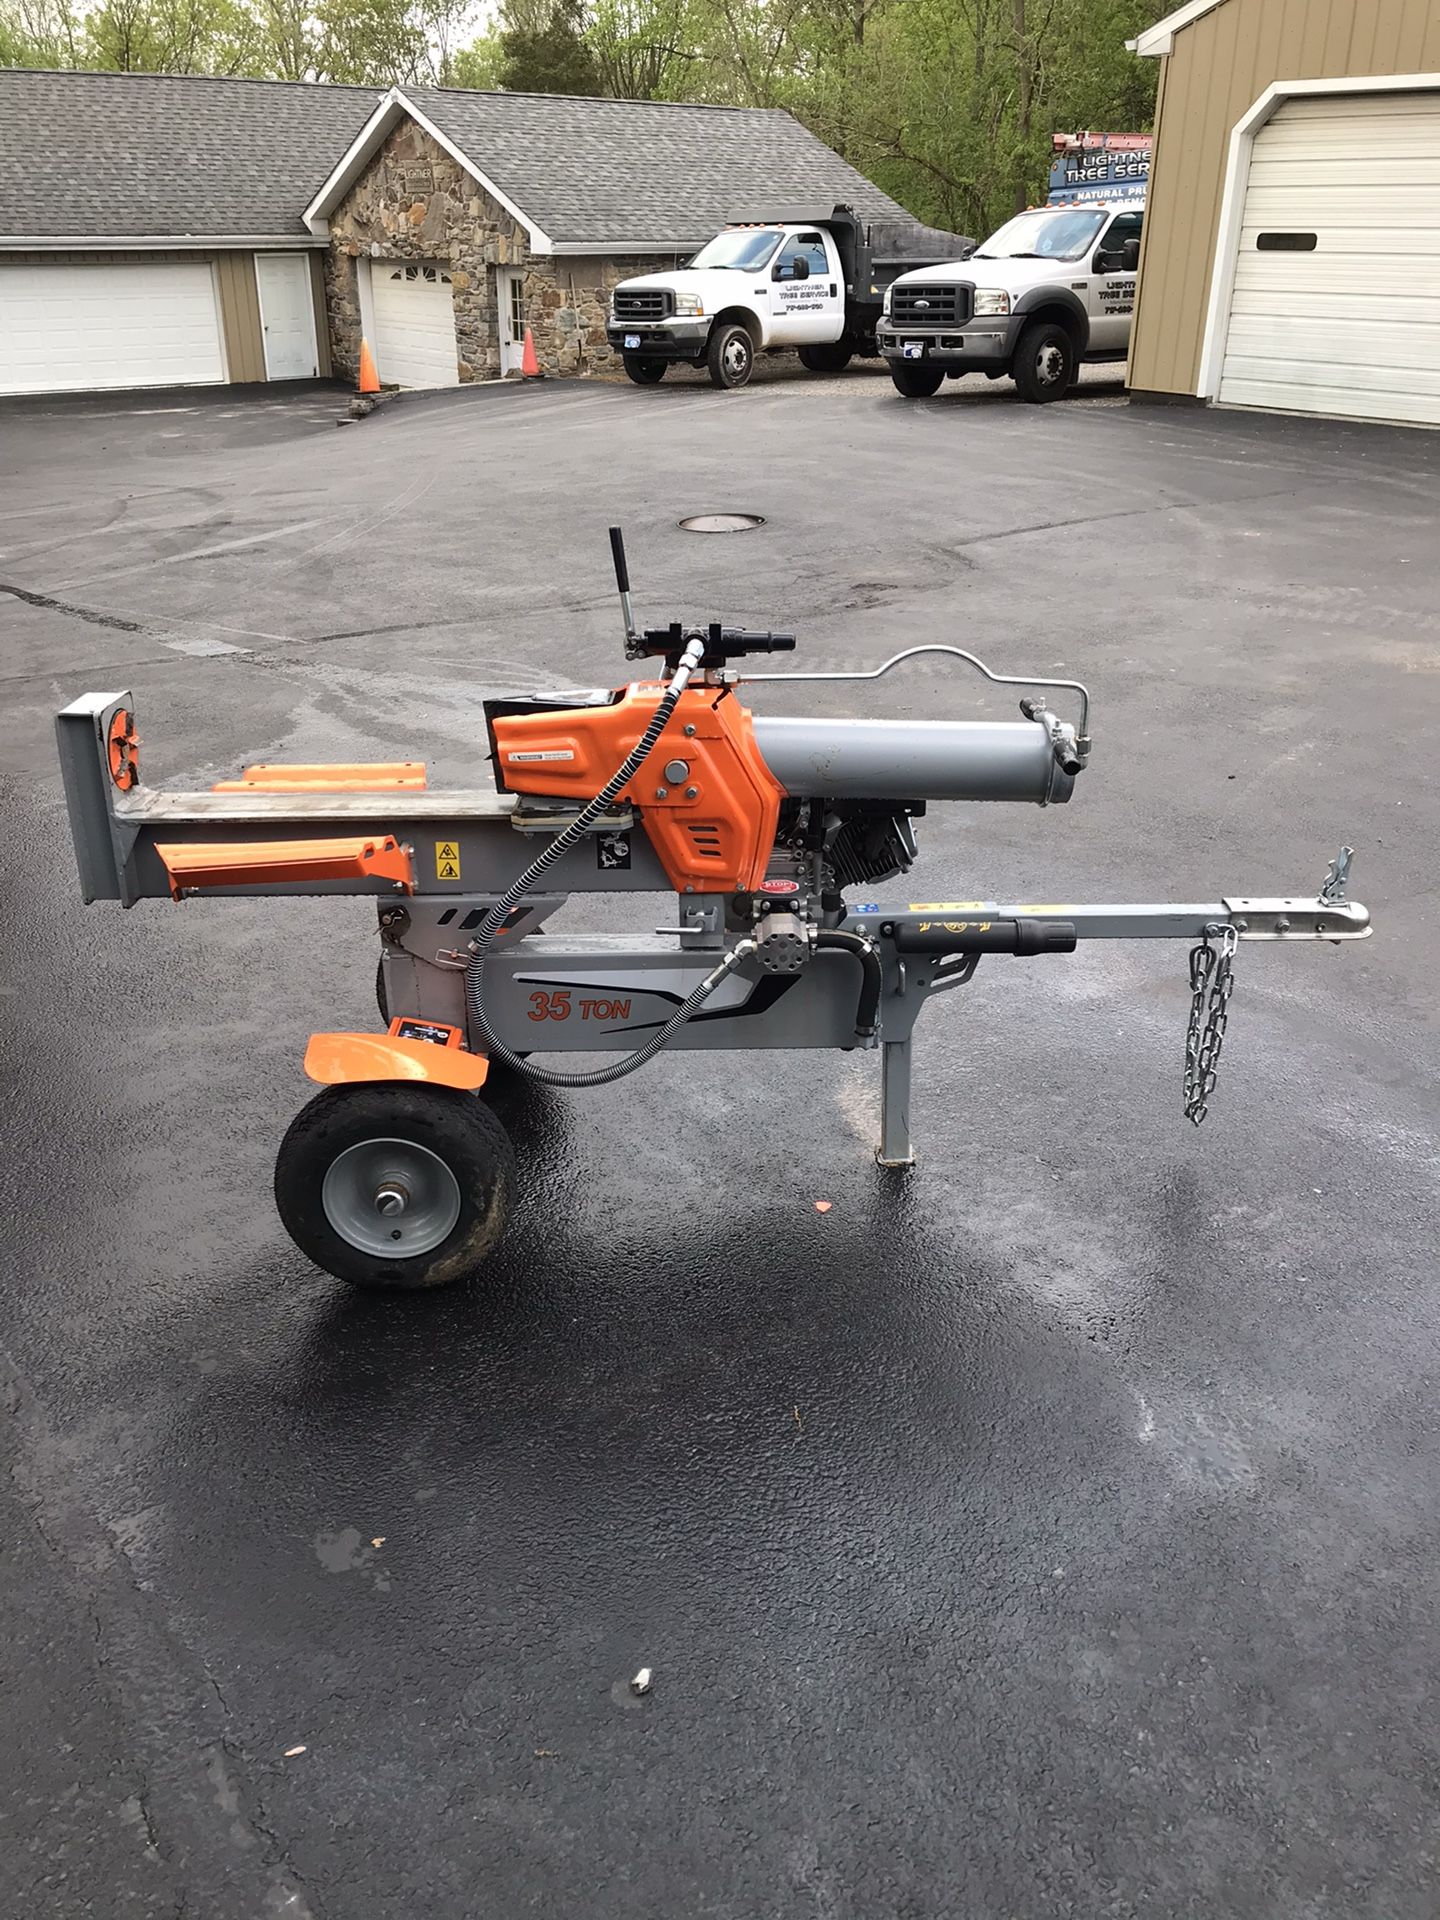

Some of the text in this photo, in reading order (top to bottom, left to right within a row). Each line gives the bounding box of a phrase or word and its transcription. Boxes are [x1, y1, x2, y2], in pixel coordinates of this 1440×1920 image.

[1066, 166, 1108, 182] TREE
[1077, 189, 1124, 200] NATURAL
[527, 991, 632, 1022] 35 TON
